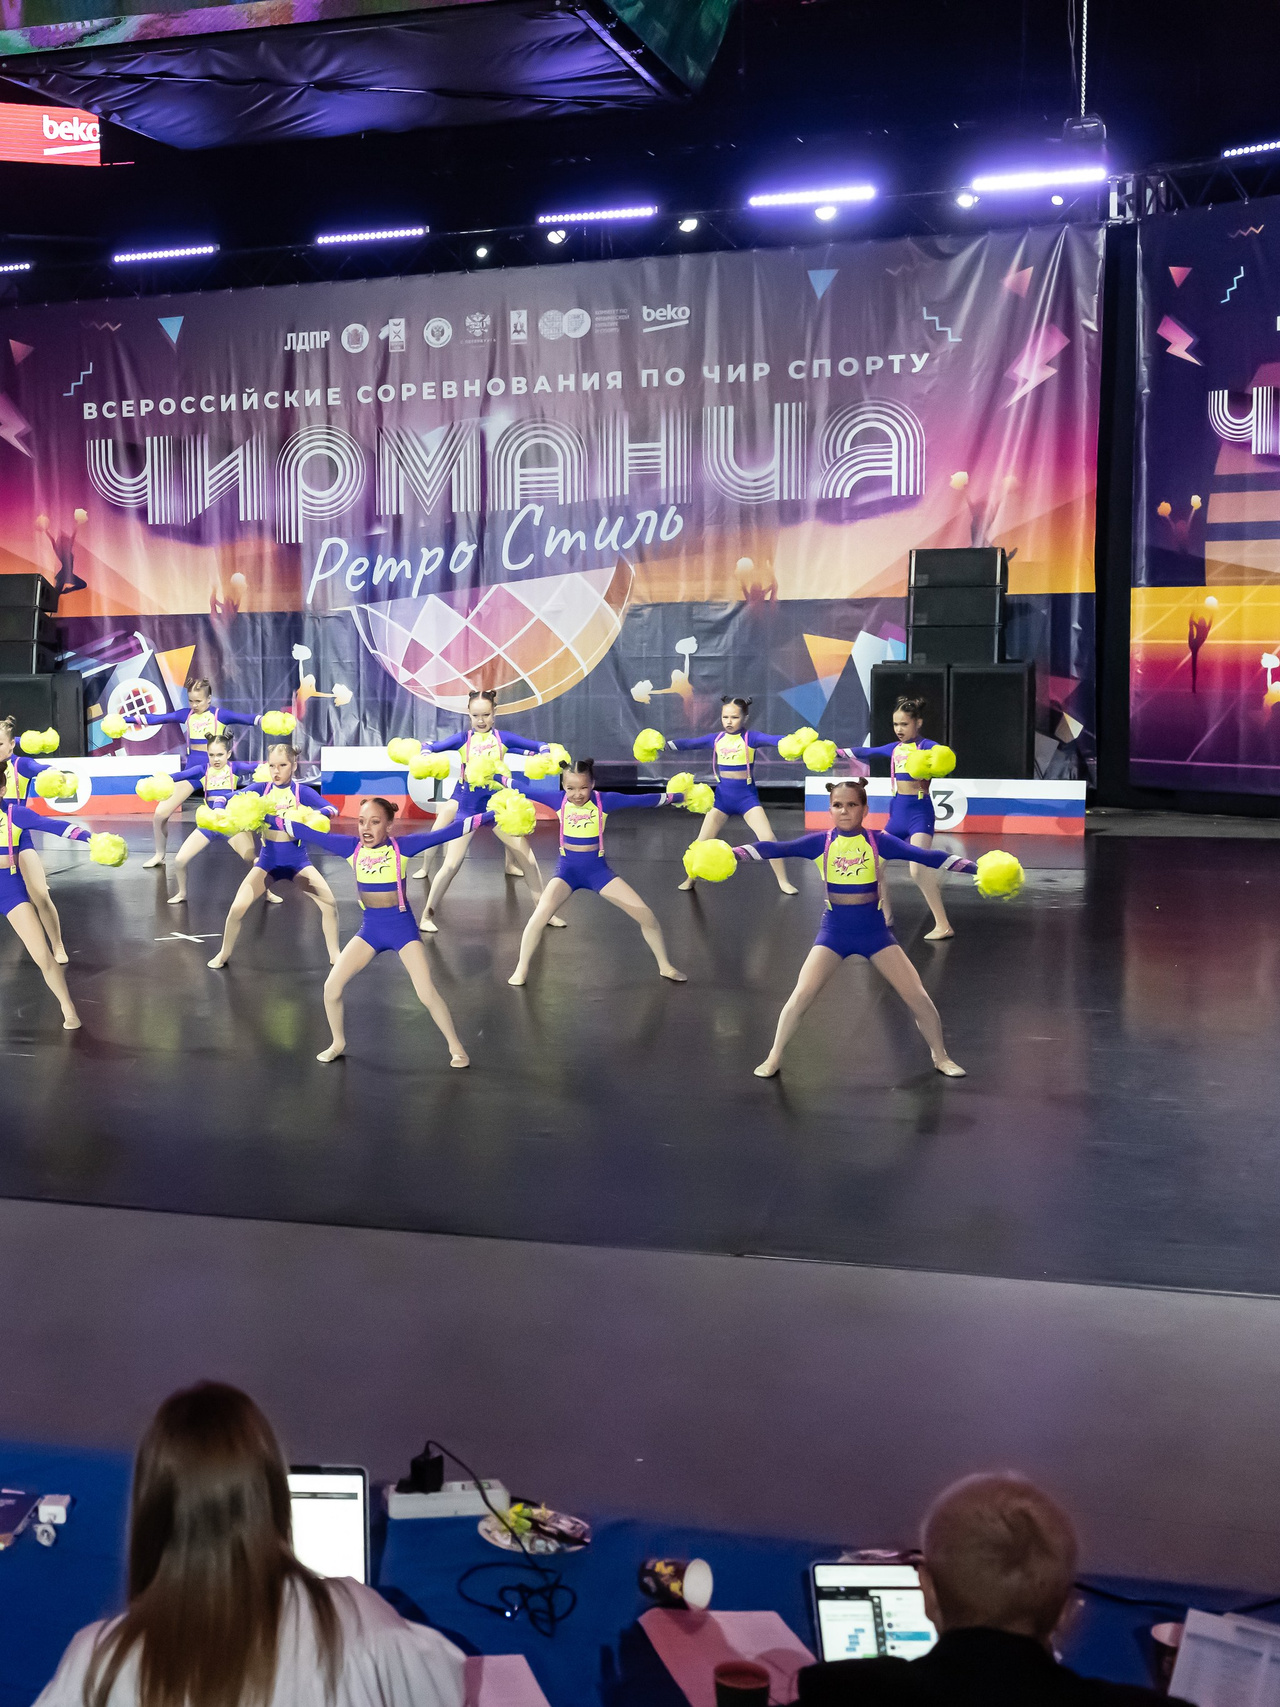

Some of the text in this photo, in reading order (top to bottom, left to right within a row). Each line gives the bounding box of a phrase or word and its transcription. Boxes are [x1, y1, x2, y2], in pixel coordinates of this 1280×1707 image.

[42, 115, 99, 143] beko
[642, 304, 691, 322] beko
[283, 330, 331, 353] ЛДПР
[82, 352, 931, 420] ВСЕРОССИЙСКИЕ СОРЕВНОВАНИЯ ПО ЧИР СПОРТУ
[305, 503, 685, 604] Ретро Стиль
[932, 790, 954, 821] 3
